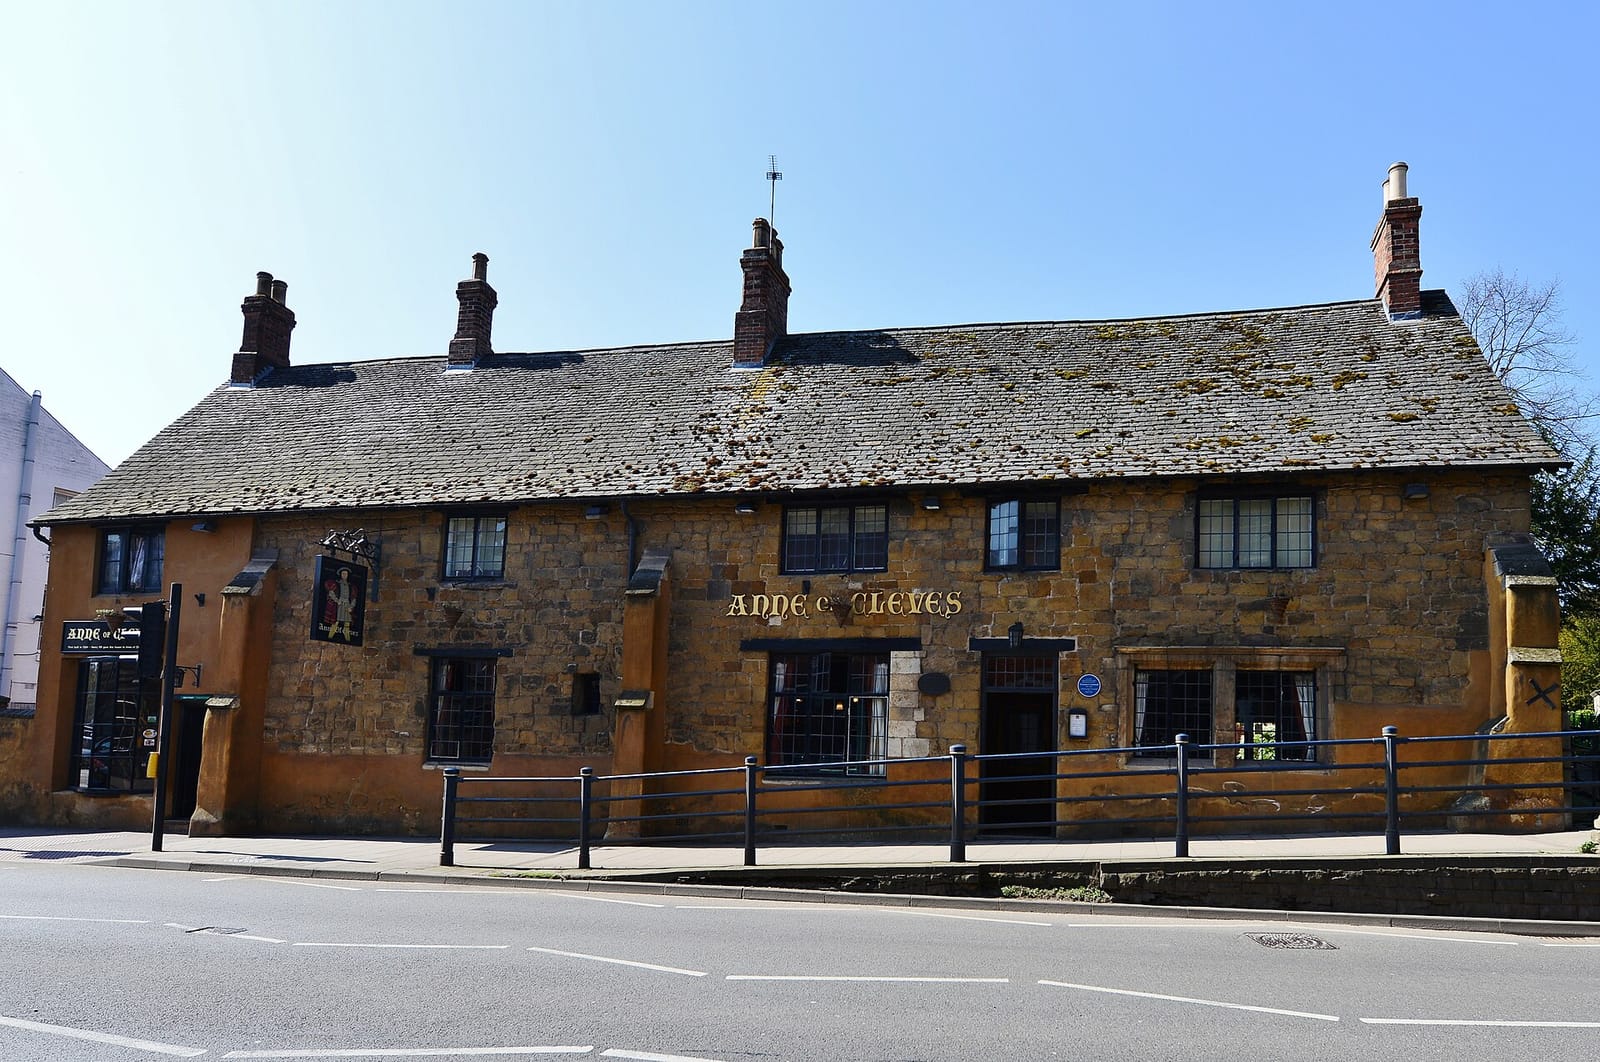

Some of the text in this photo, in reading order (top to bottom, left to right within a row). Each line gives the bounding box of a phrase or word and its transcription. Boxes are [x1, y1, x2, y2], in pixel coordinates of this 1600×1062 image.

[726, 593, 809, 620] ANNE
[851, 591, 963, 619] CLEVES
[66, 628, 101, 641] ANNE
